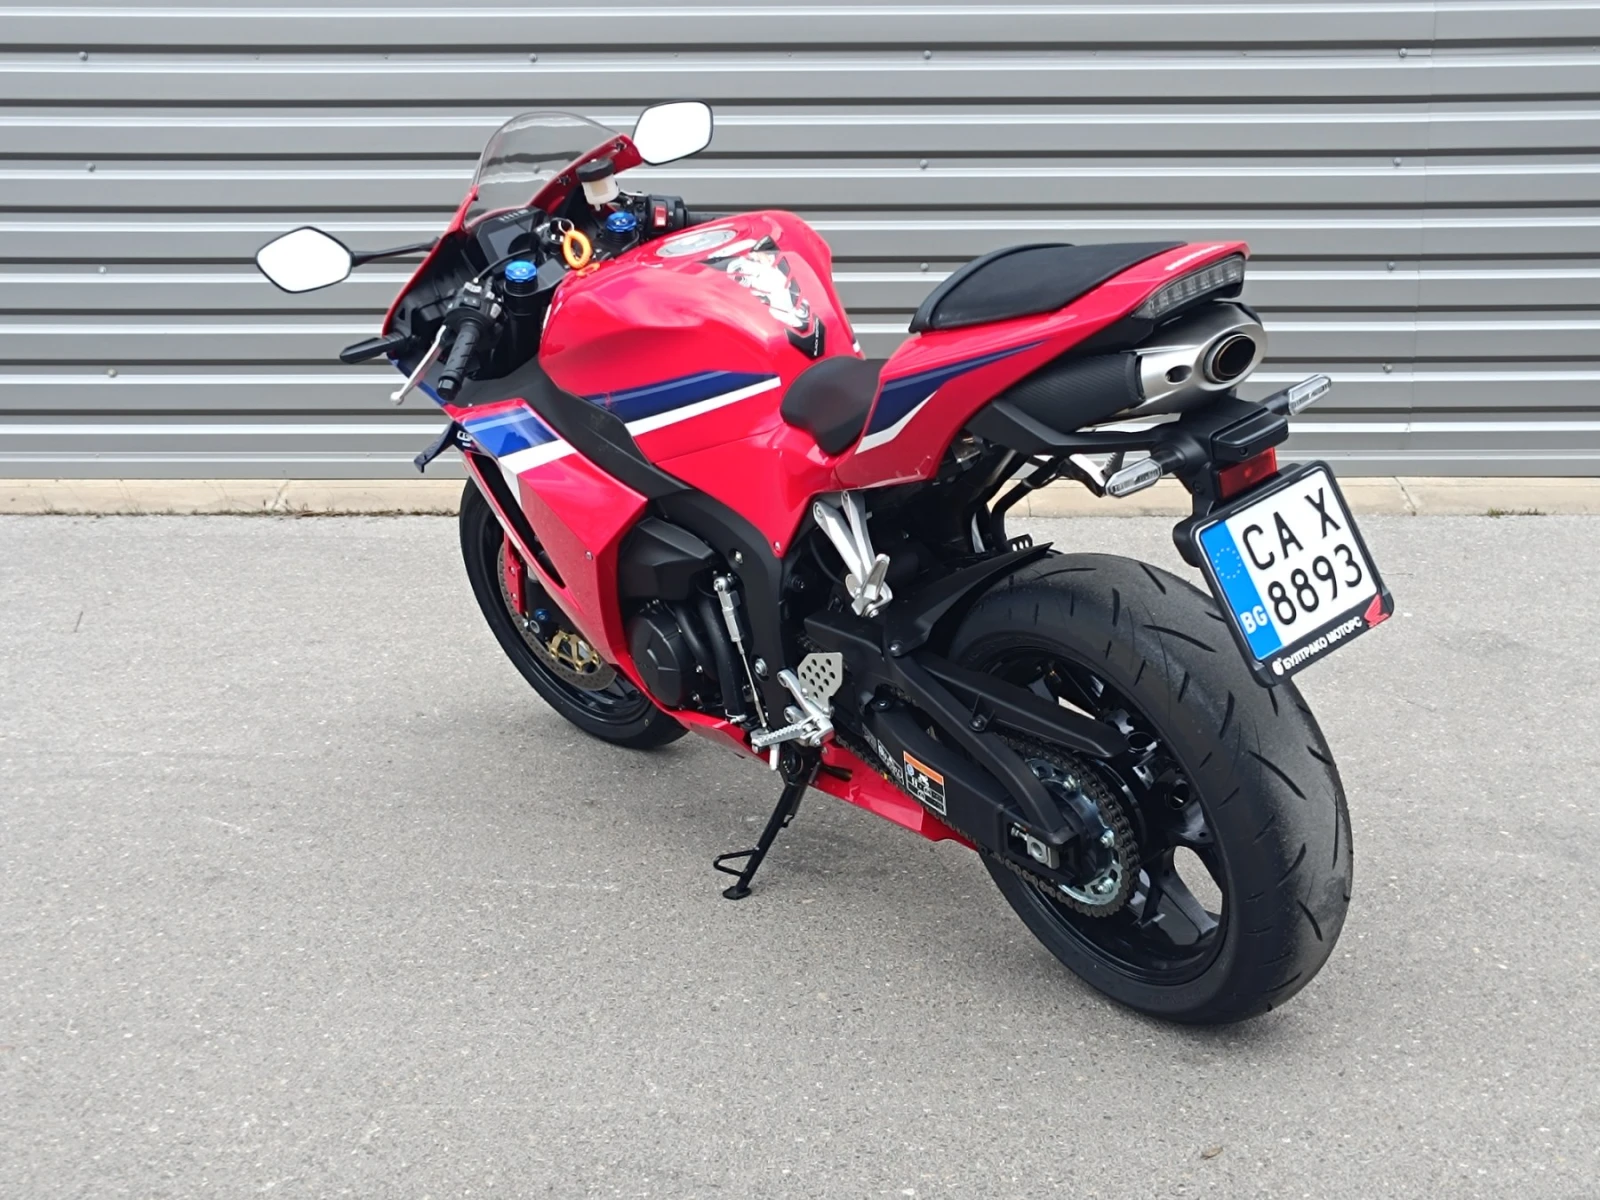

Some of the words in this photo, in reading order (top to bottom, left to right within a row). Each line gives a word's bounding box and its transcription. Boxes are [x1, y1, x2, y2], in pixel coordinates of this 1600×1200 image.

[1242, 511, 1304, 570] CA
[1304, 487, 1341, 538] X
[1267, 543, 1362, 625] 8893
[1239, 605, 1268, 634] BG
[1282, 637, 1328, 670] БУЛТРАКО
[1326, 616, 1362, 644] МОТОРС
